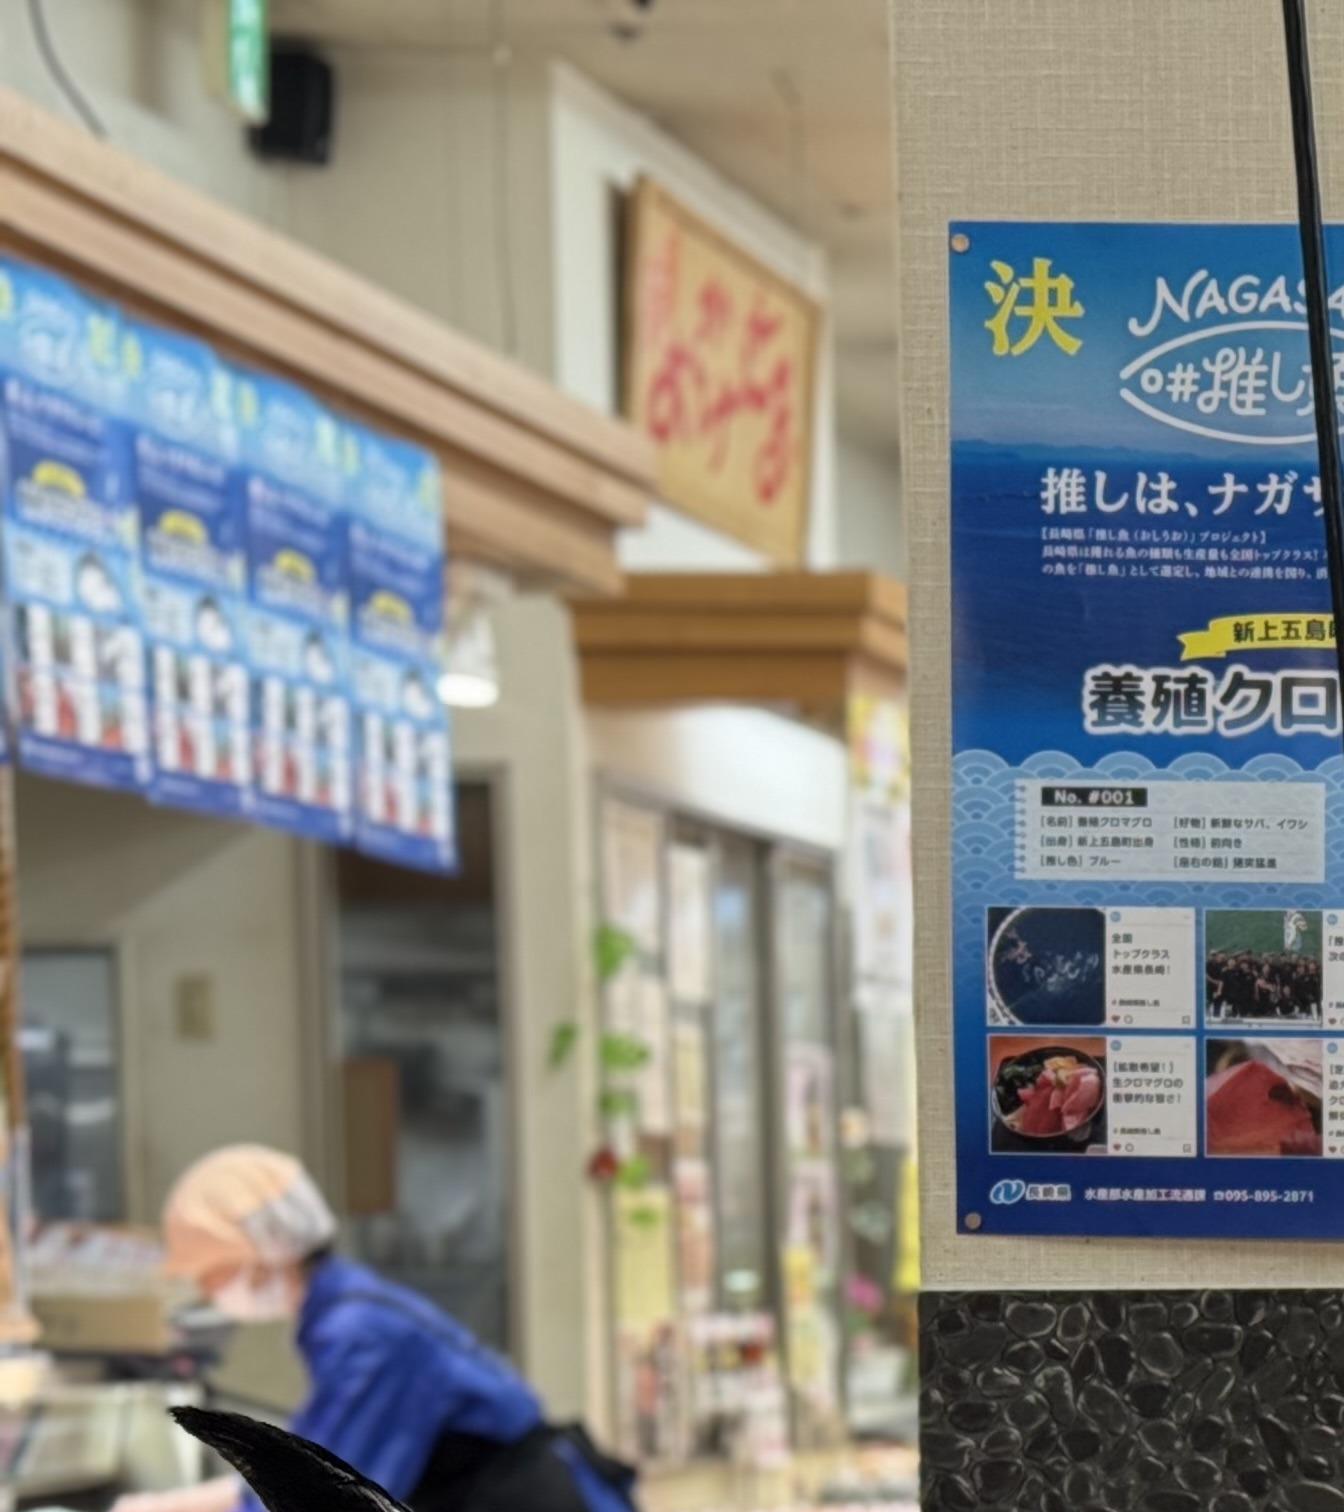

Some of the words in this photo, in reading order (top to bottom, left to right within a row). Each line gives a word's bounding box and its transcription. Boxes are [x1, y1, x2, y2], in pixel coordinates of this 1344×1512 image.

[985, 258, 1083, 356] 決
[1054, 789, 1083, 806] No.
[1088, 788, 1135, 806] #001
